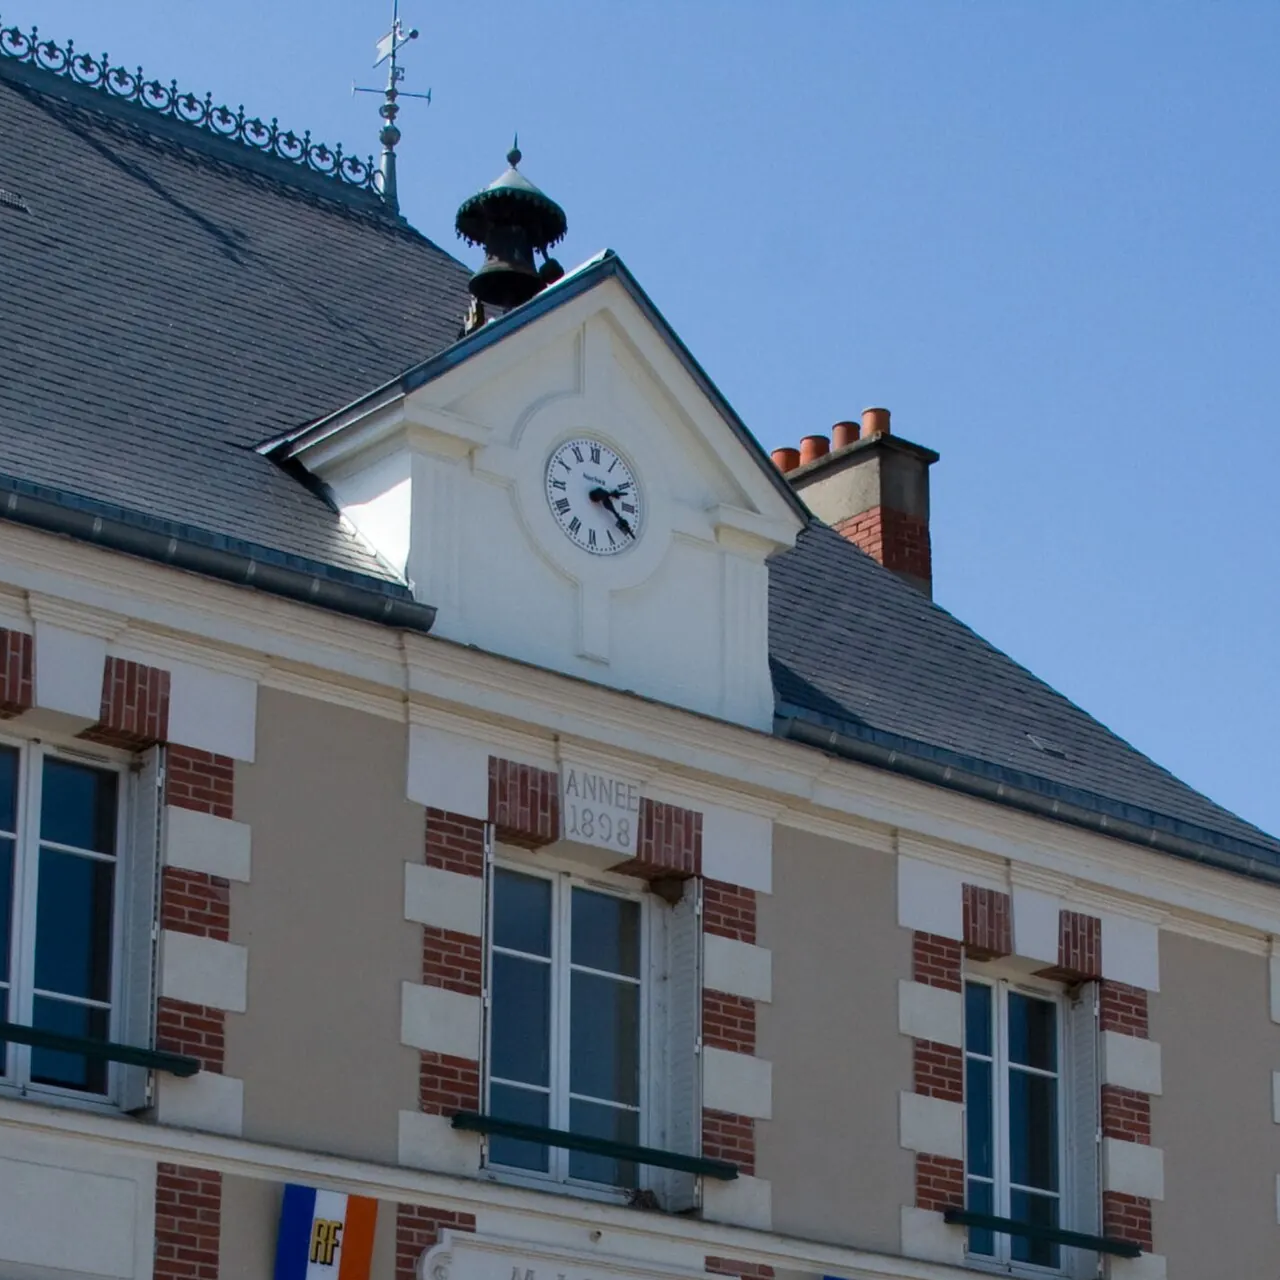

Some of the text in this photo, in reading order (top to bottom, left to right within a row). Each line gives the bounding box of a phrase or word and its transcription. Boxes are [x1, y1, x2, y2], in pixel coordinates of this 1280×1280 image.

[565, 768, 638, 812] ANNEE
[569, 803, 631, 847] 1898
[310, 1218, 343, 1266] RF
